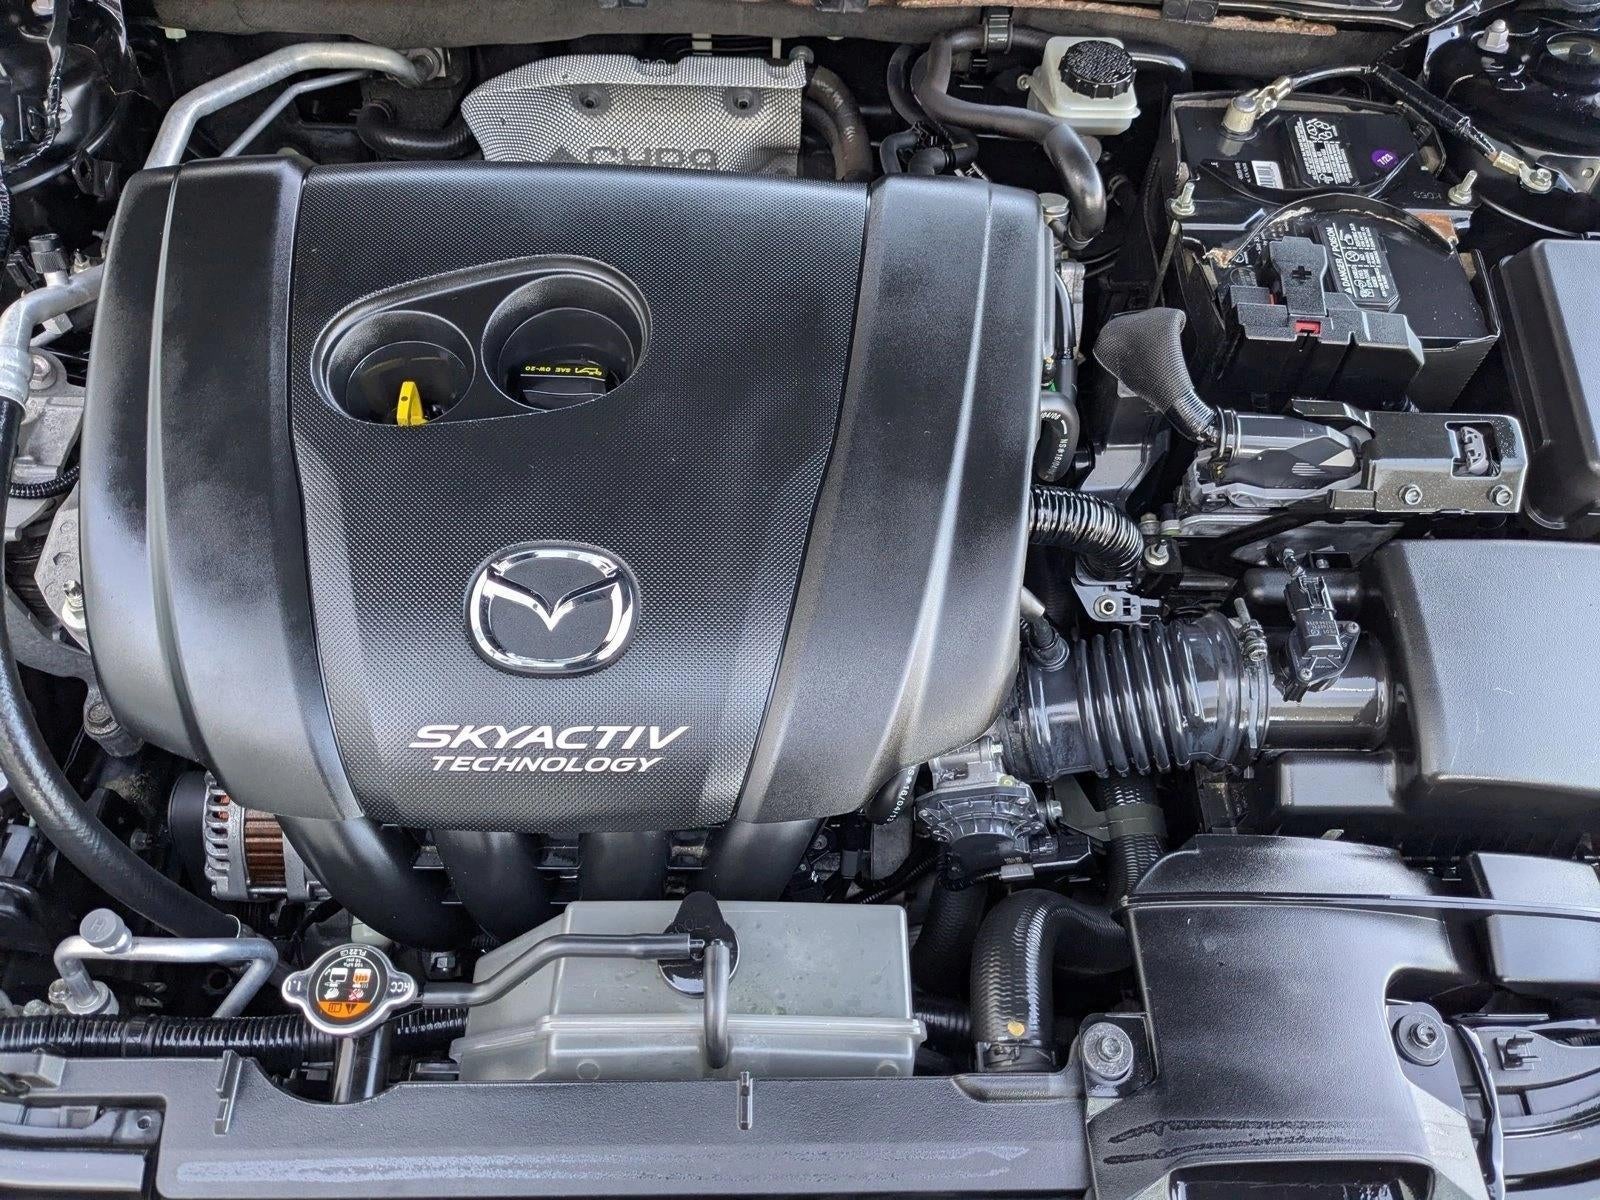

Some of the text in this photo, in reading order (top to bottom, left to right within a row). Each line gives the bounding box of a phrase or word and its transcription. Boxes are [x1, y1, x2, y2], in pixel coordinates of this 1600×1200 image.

[1376, 153, 1393, 165] 7/23
[1326, 226, 1341, 252] POISON
[1335, 258, 1351, 287] DANGER
[408, 724, 690, 750] SKYACTIV
[432, 755, 664, 773] TECHNOLOGY
[287, 981, 302, 991] 1.1
